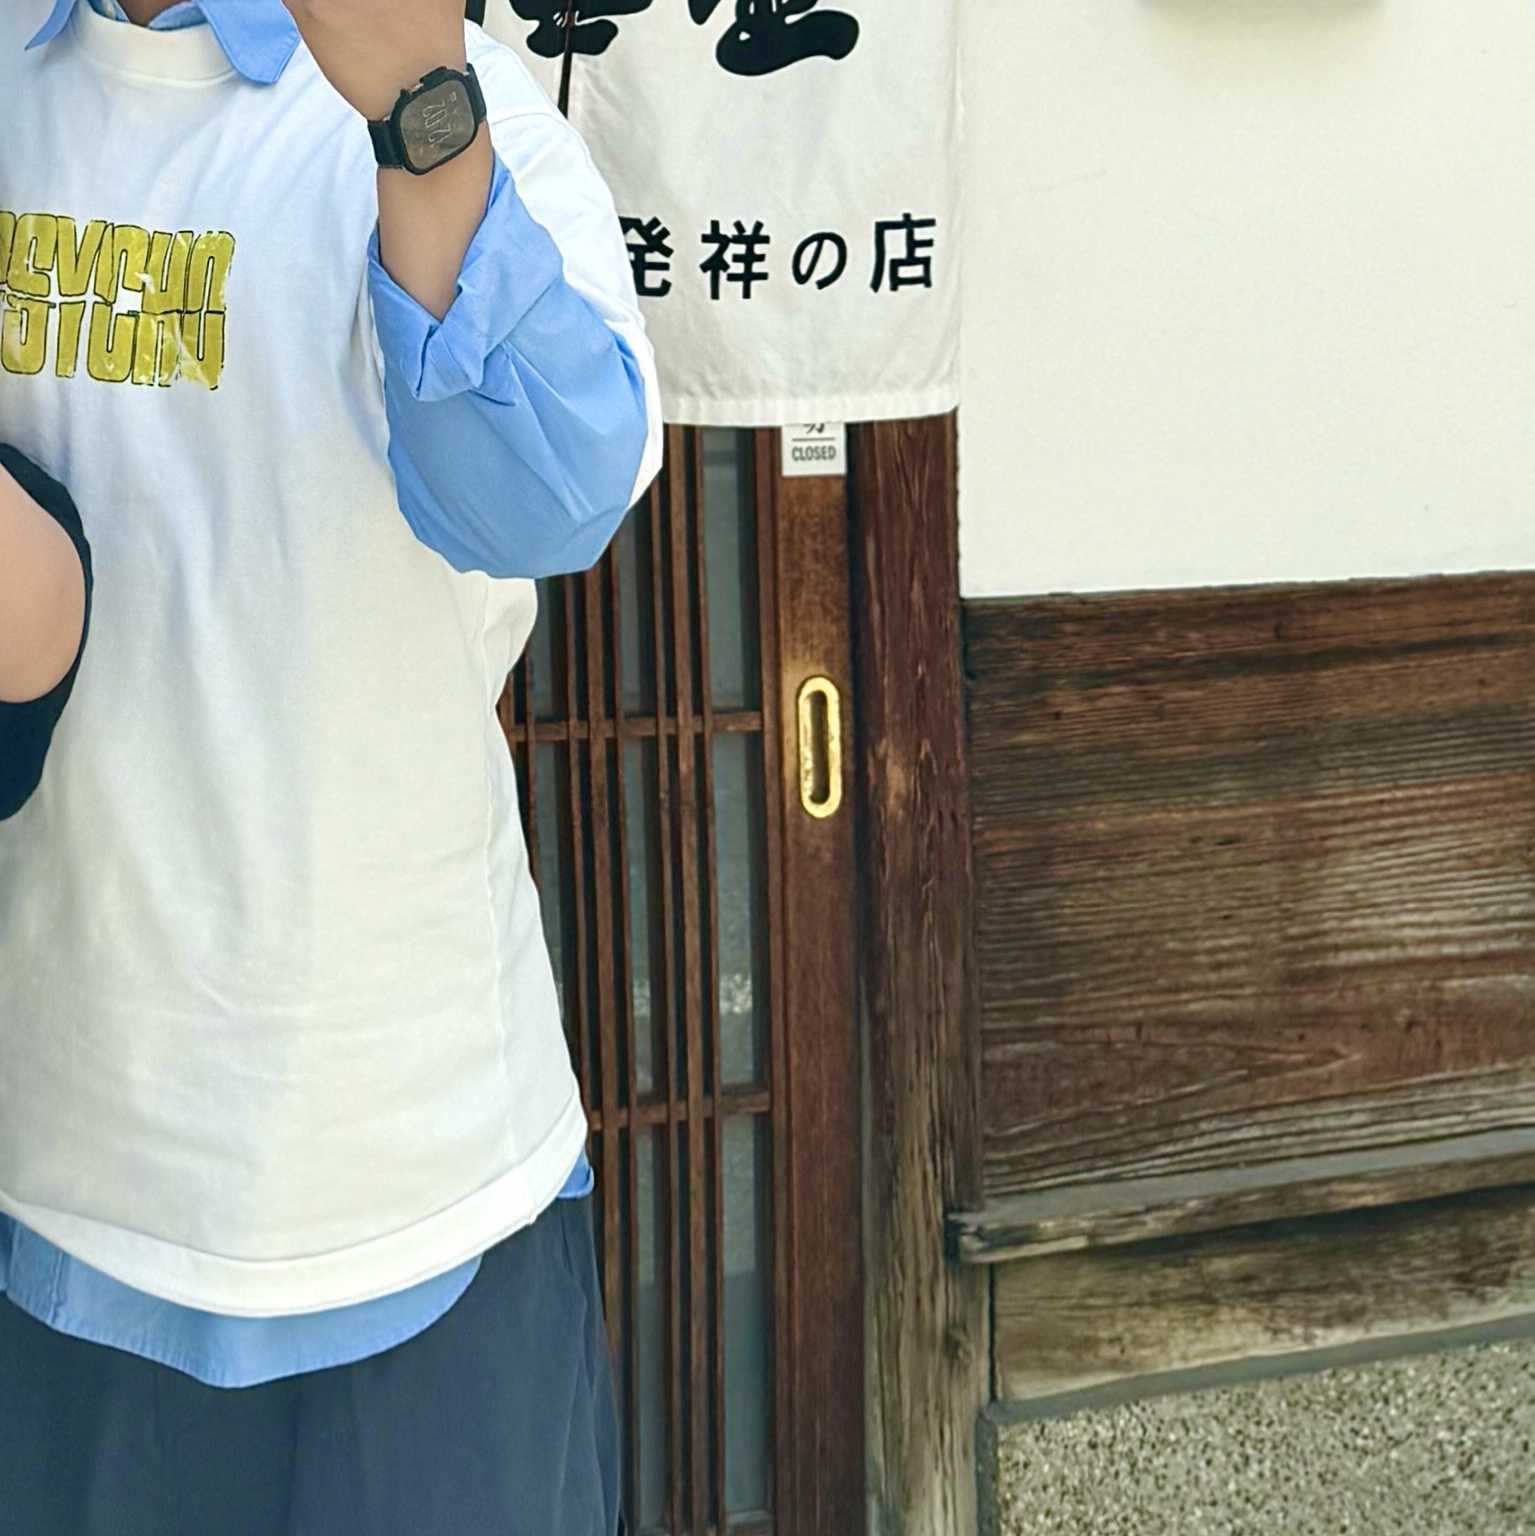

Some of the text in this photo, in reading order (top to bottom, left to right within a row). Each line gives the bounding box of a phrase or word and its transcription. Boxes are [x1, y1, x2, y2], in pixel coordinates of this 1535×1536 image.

[618, 213, 936, 301] 発祥の店
[791, 445, 837, 462] CLOSED
